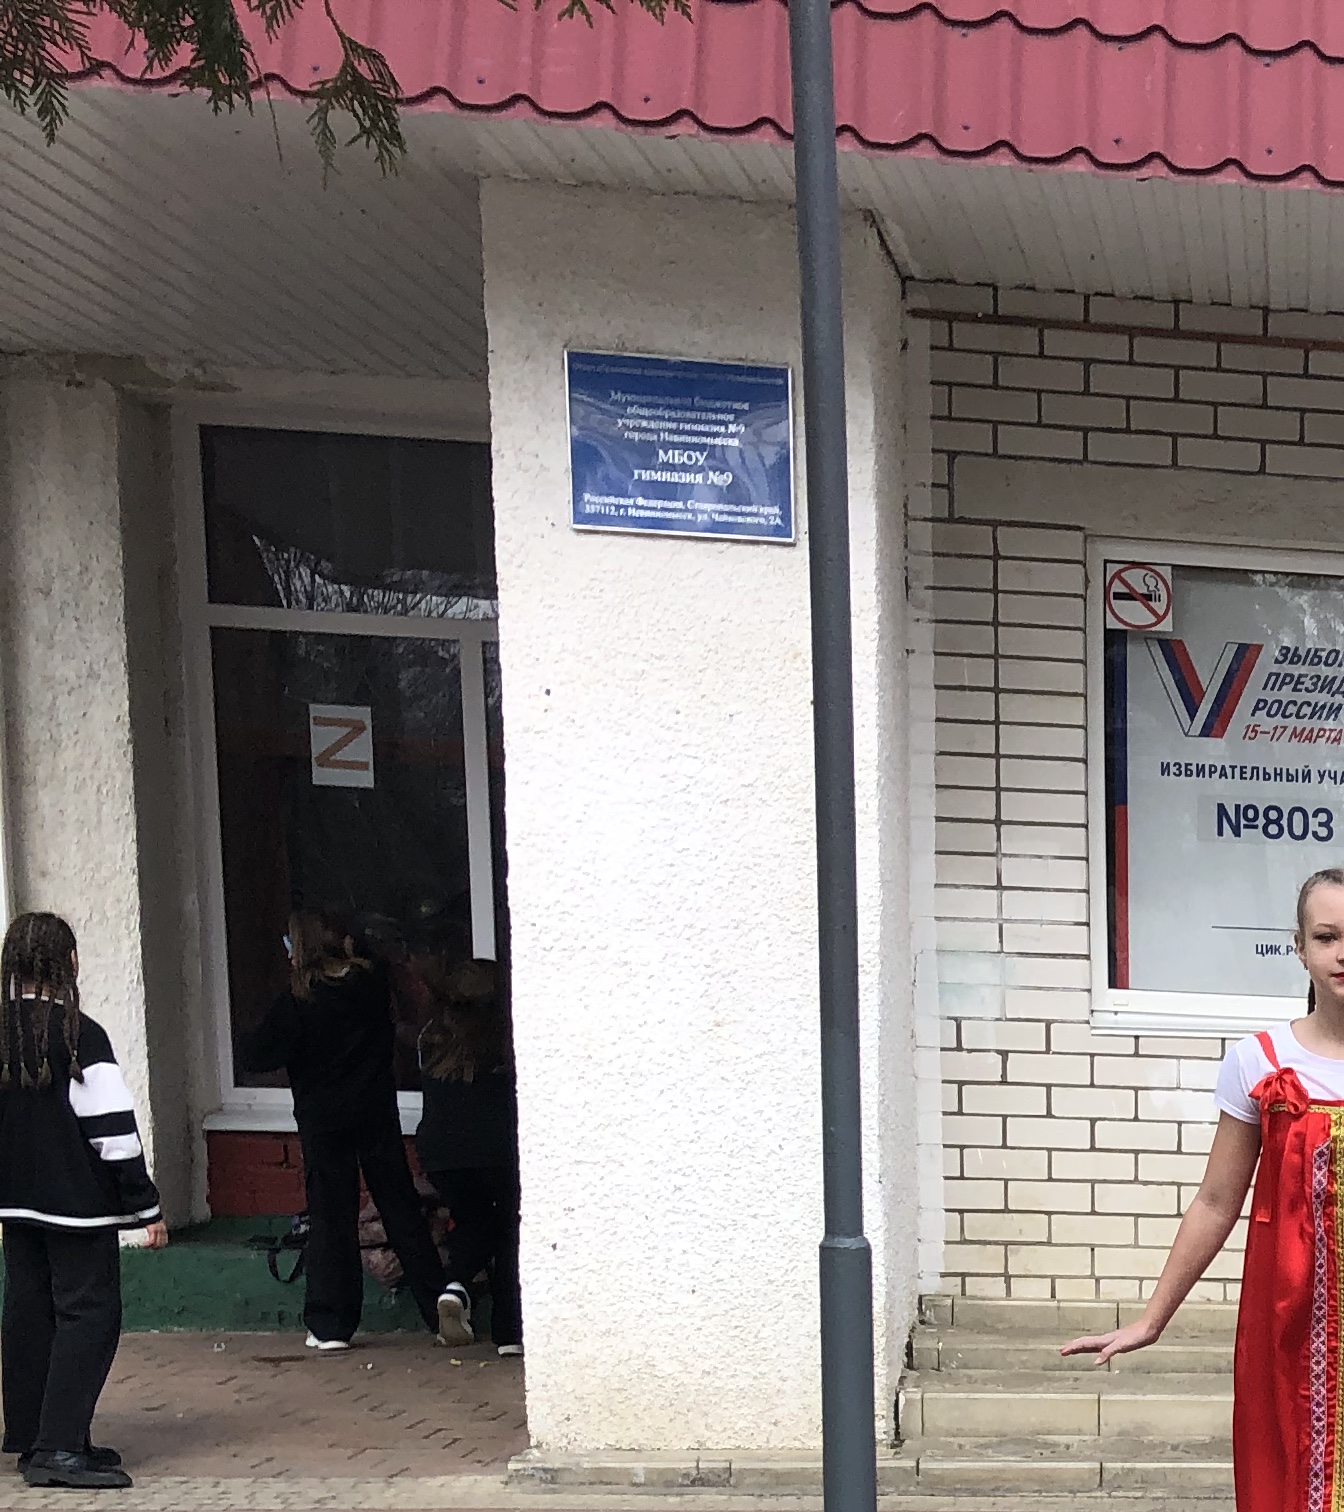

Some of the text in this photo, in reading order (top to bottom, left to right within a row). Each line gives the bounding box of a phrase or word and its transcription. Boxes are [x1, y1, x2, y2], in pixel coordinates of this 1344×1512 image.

[658, 449, 708, 465] МБОУ
[633, 469, 733, 487] гимназия №9
[1251, 698, 1344, 721] РОССИИ
[312, 715, 370, 771] Z
[1288, 726, 1343, 746] МАРТА
[1160, 760, 1312, 784] ИЗБИРАТЕЛЬНЫЙ
[1216, 802, 1335, 842] №803
[1255, 943, 1298, 957] ЦИК.Р
